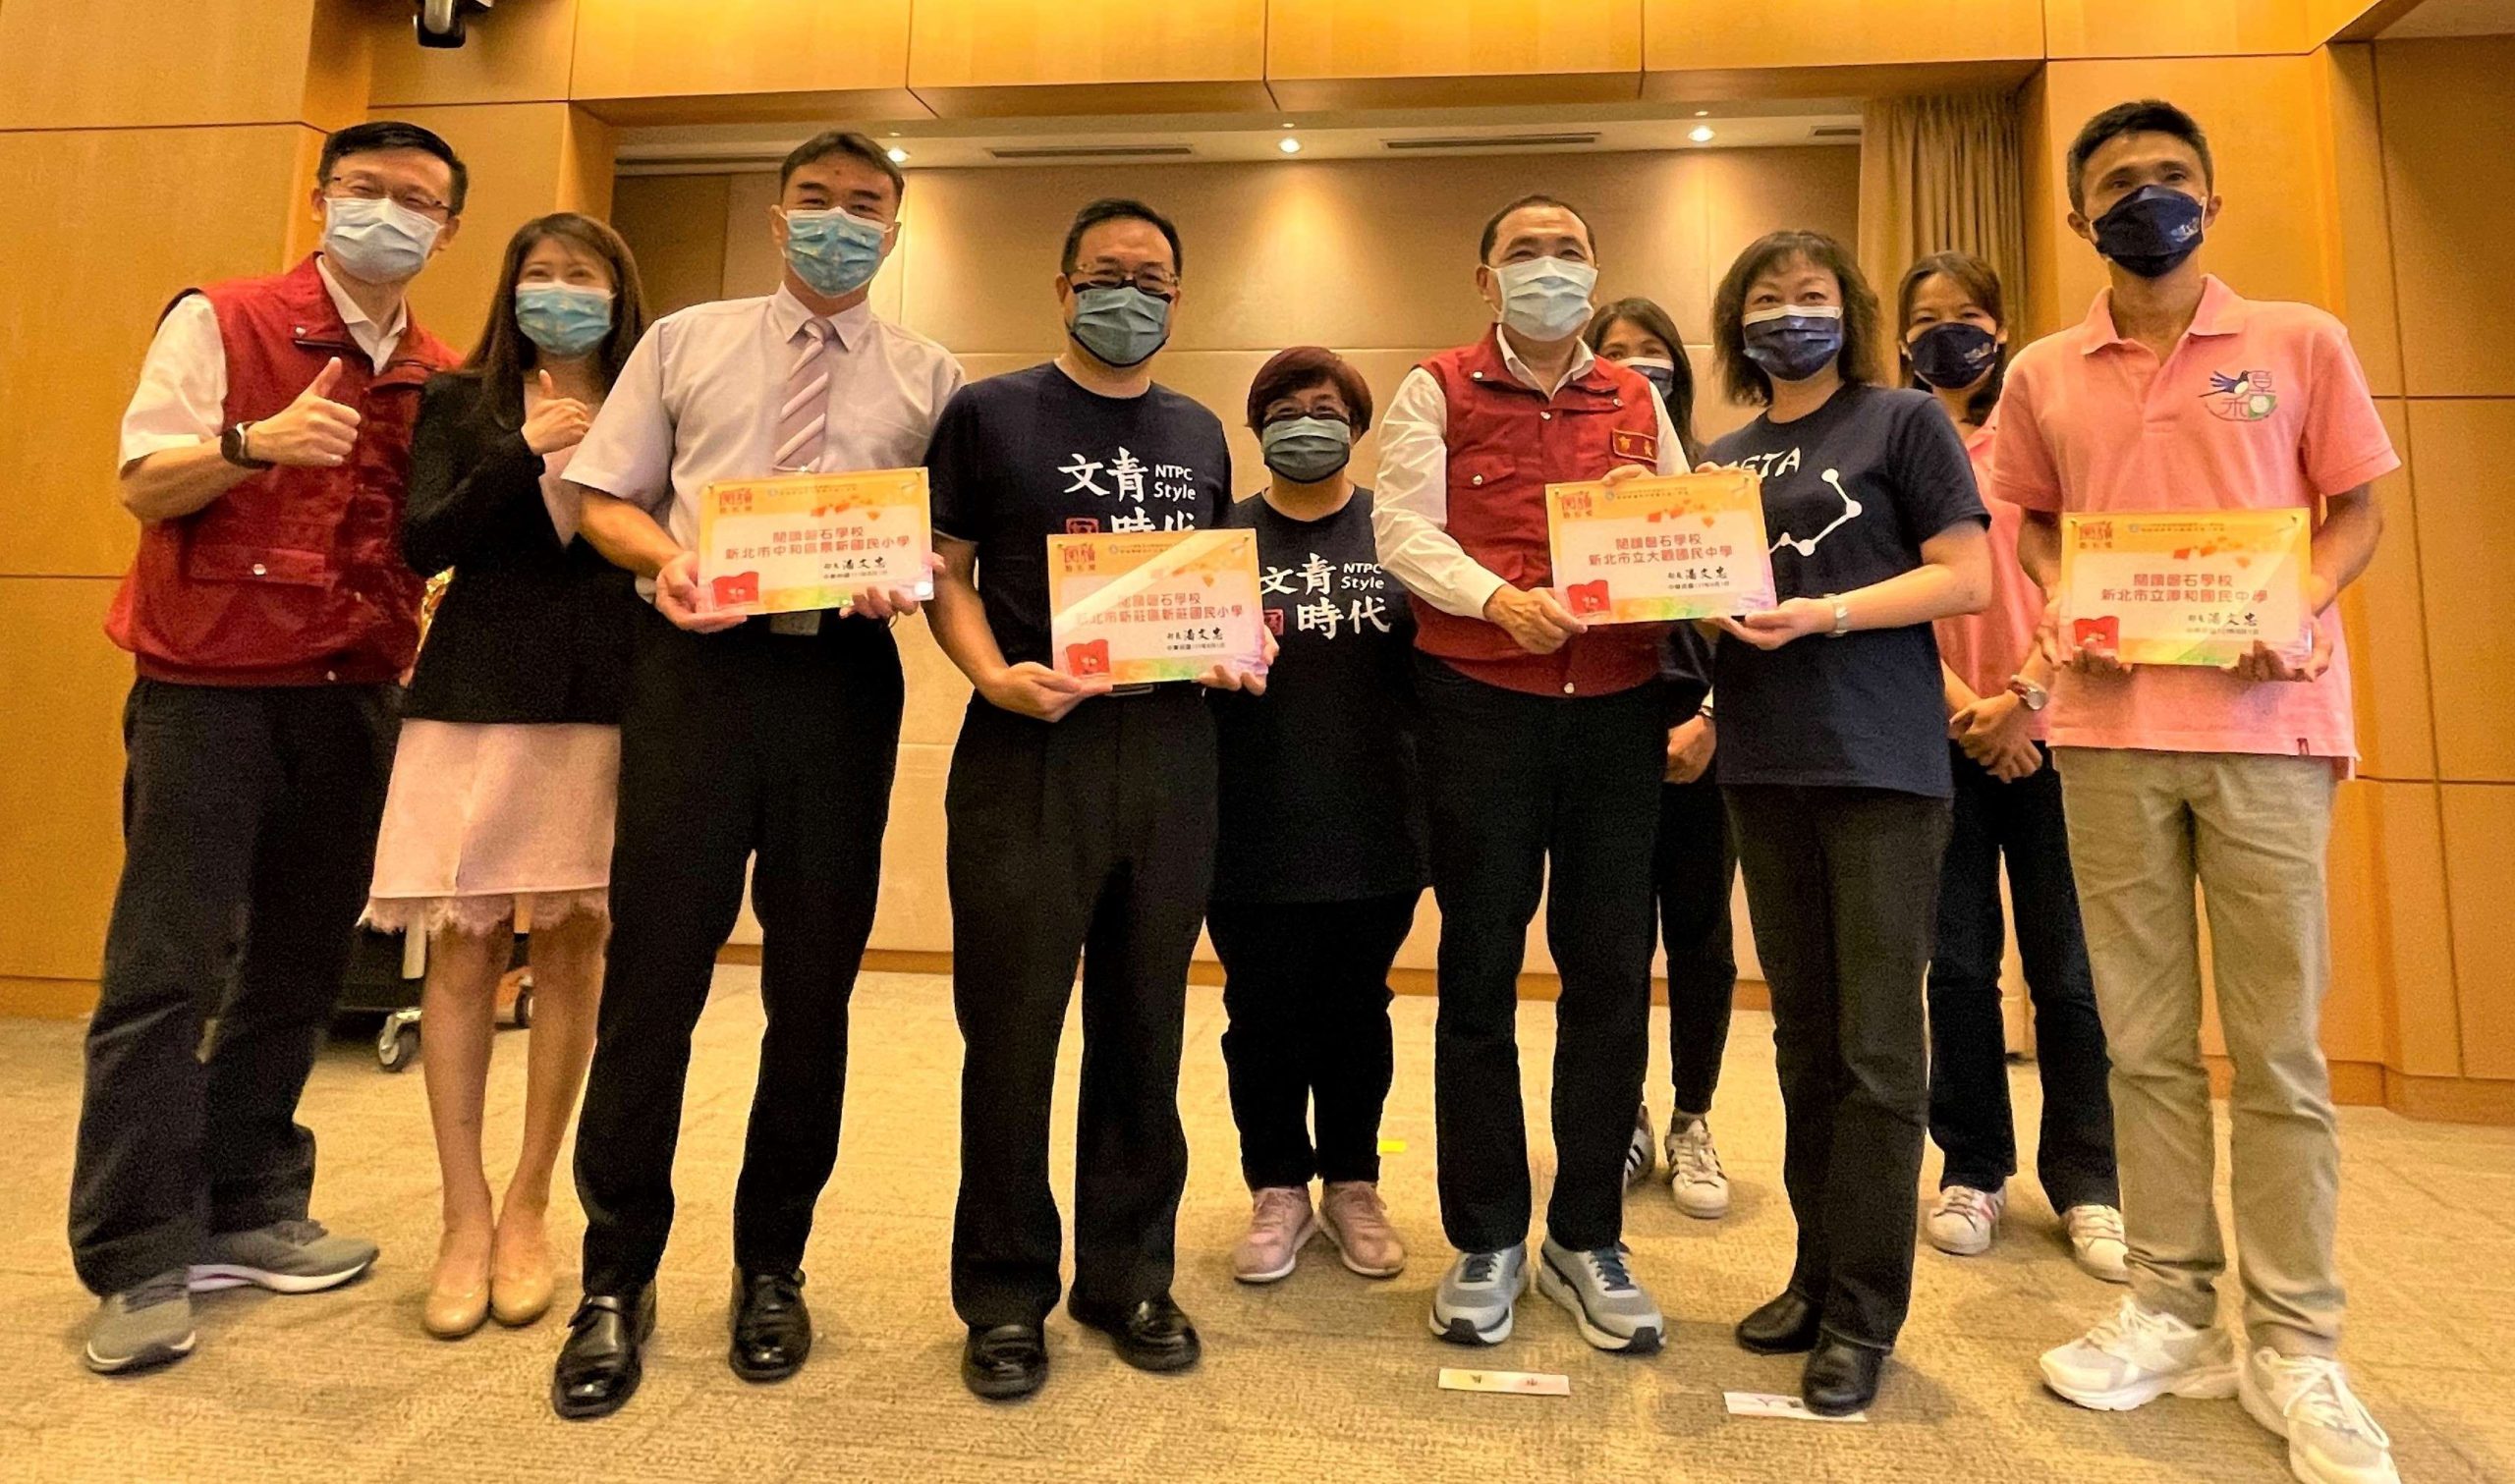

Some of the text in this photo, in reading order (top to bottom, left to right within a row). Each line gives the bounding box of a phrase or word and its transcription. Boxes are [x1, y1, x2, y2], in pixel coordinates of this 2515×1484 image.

[1057, 446, 1148, 503] 文青
[1154, 464, 1194, 481] NTPC
[1153, 481, 1197, 502] Style
[1259, 552, 1337, 595] 文青
[1343, 563, 1382, 575] NTPC
[1341, 577, 1384, 591] Style
[1297, 596, 1391, 639] 時代
